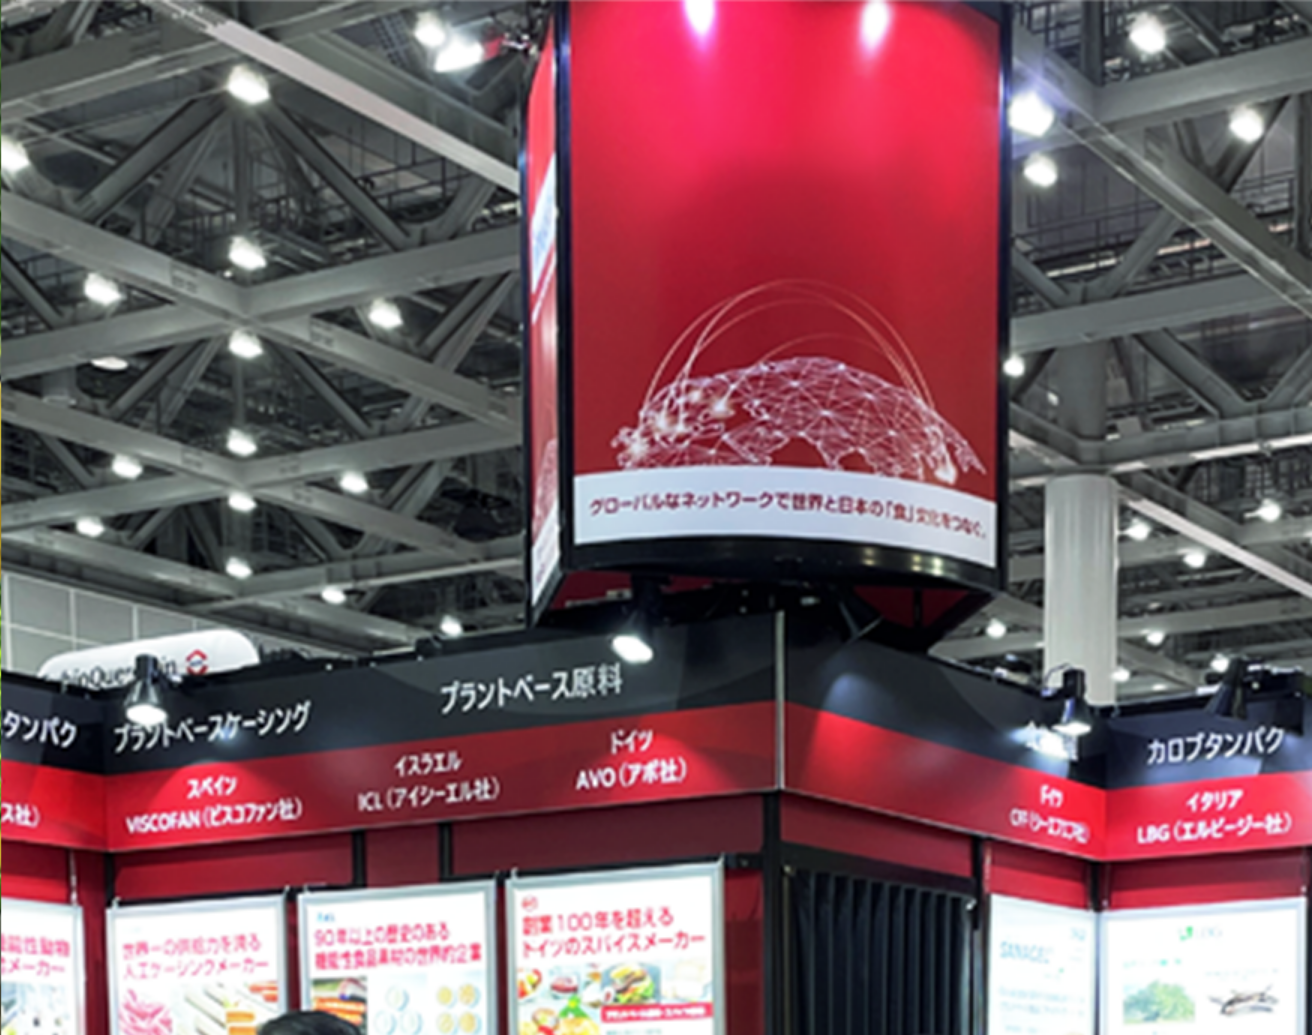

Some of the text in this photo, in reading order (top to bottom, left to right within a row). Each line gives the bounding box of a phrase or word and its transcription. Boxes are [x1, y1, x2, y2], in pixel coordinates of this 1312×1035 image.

[441, 663, 623, 714] プラントベース原料
[114, 701, 312, 753] プラントベースケーシング
[611, 730, 653, 754] ドイツ
[1148, 726, 1284, 765] カロブタンパク
[394, 751, 463, 778] イスラエル
[187, 775, 237, 799] スペイン
[1186, 789, 1244, 812] イタリア
